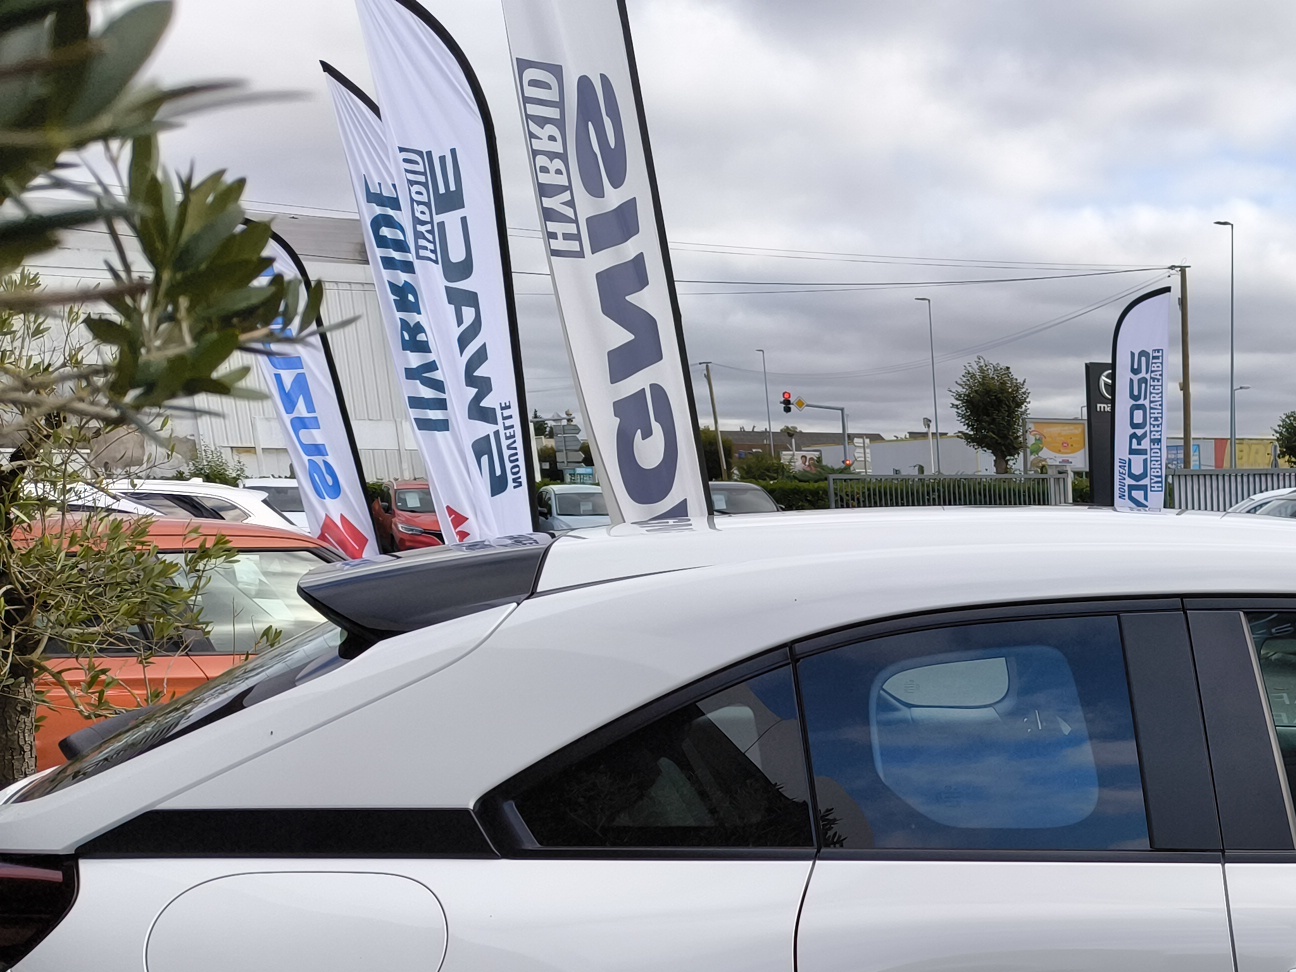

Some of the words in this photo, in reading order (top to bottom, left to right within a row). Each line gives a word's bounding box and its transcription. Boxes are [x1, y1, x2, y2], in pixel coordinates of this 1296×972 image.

[1127, 349, 1150, 509] ACROSS
[1150, 349, 1163, 439] RECHARGEABLE
[1118, 457, 1128, 501] NOUVEAU
[1150, 441, 1163, 492] HYBRIDE
